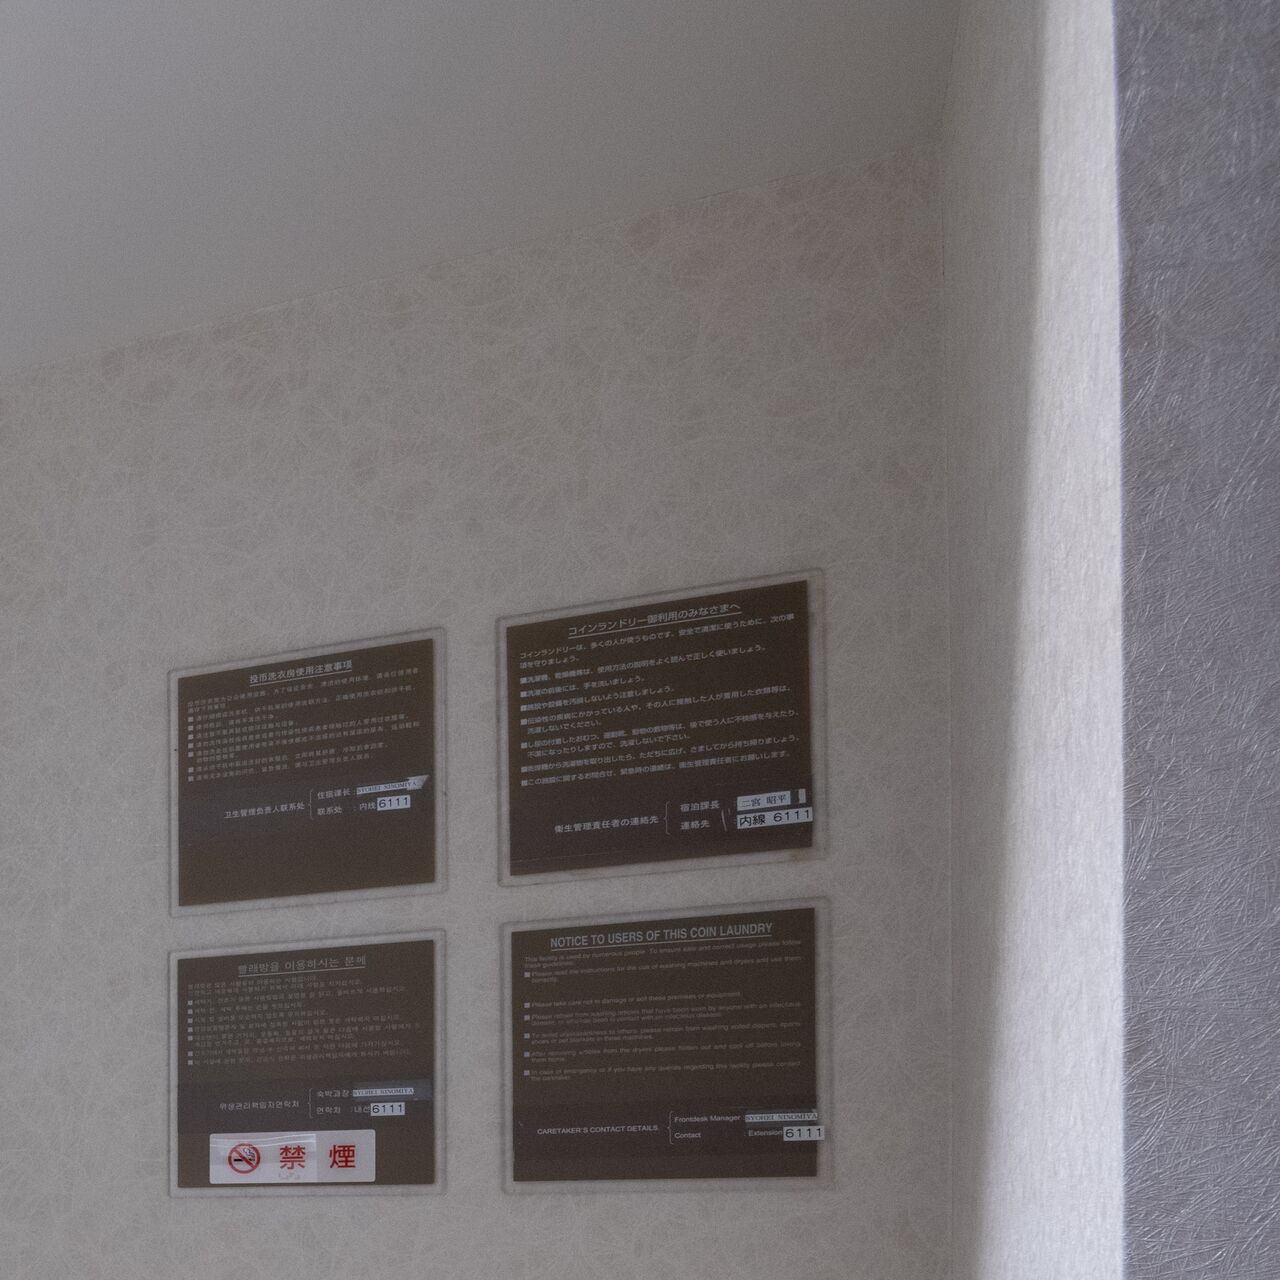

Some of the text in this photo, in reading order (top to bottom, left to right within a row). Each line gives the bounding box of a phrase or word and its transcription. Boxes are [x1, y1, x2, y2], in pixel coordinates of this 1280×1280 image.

[568, 604, 741, 636] コインランドリー御利用のみなさまへ
[379, 797, 409, 809] 6111
[680, 801, 719, 812] 宿泊課長
[555, 816, 659, 833] 衛生管理責任者の連絡先
[680, 810, 810, 830] 連絡先 内線 6111
[551, 923, 772, 948] NOTICE TO USERS OF THIS COIN LAUNDRY
[284, 959, 339, 970] 이용하시는
[373, 1104, 403, 1113] 6111
[785, 1127, 822, 1138] 6111
[280, 1145, 355, 1169] 禁煙
